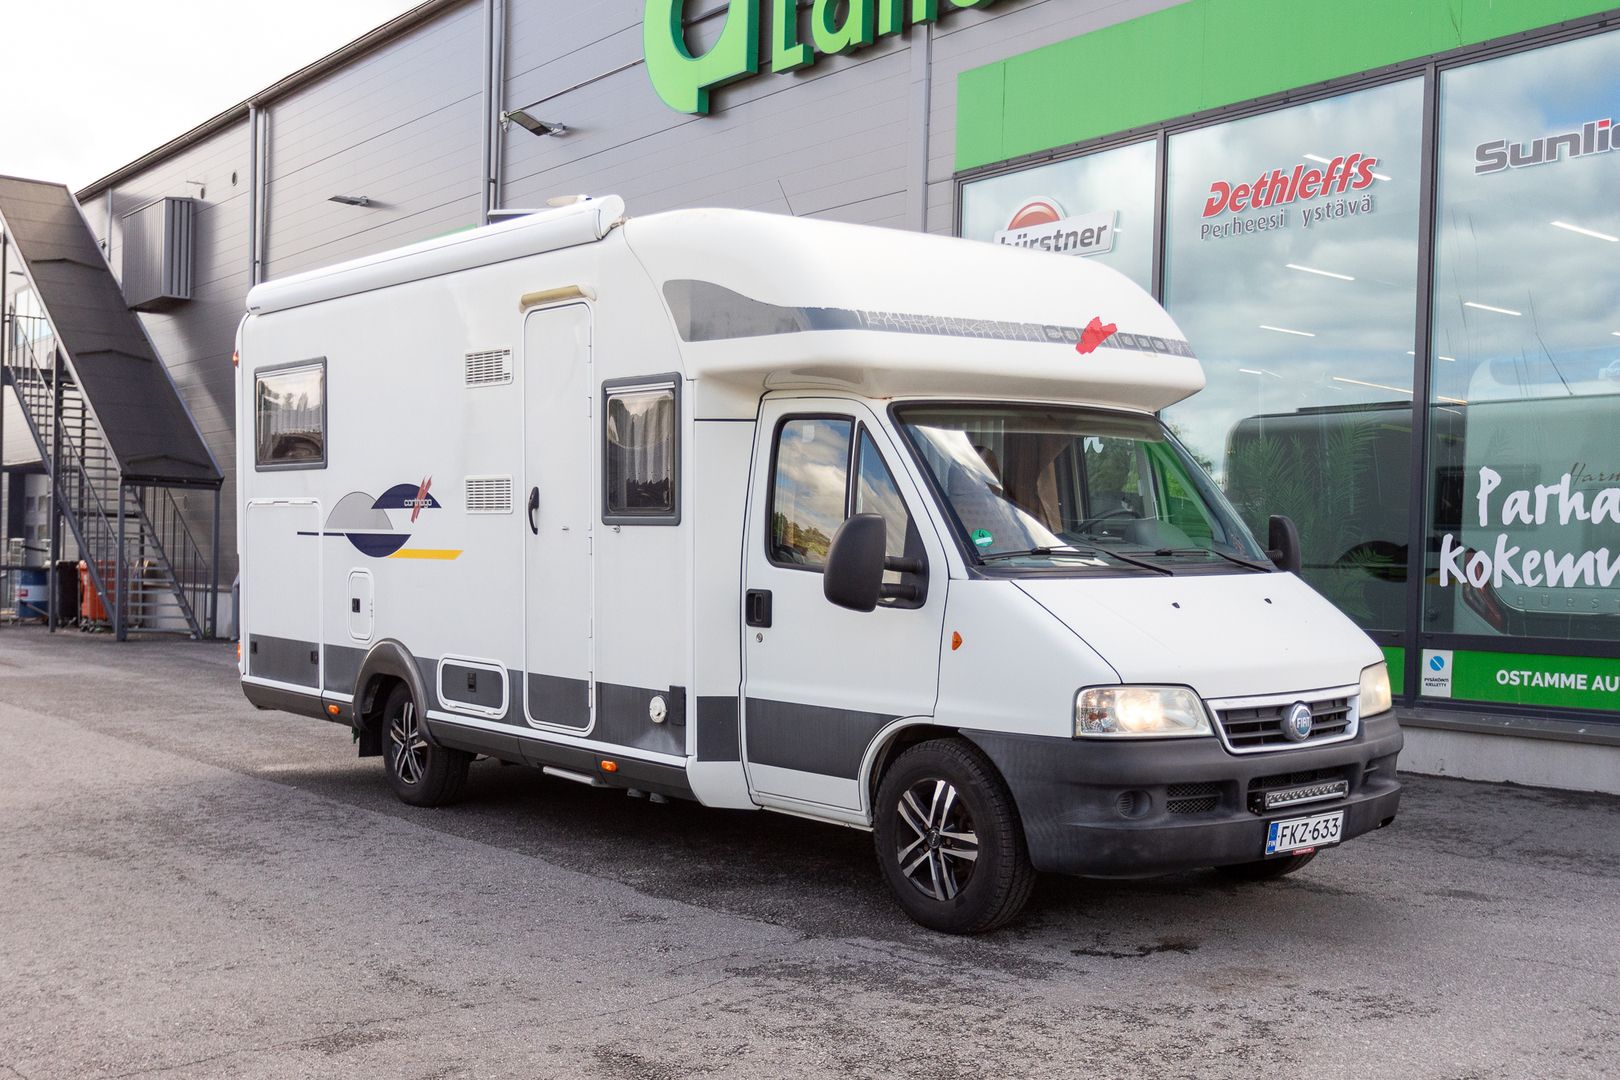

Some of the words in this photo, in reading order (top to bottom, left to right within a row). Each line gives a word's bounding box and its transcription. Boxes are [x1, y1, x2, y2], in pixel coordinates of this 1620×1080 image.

[1202, 152, 1378, 218] Dethleffs
[1200, 208, 1286, 240] Perheesi
[1302, 194, 1374, 227] ystävä
[1000, 224, 1108, 253] ürstner
[1496, 670, 1587, 690] OSTAMME
[1592, 675, 1620, 692] AU
[1296, 716, 1311, 729] FIAT
[1279, 817, 1340, 847] FKZ-633
